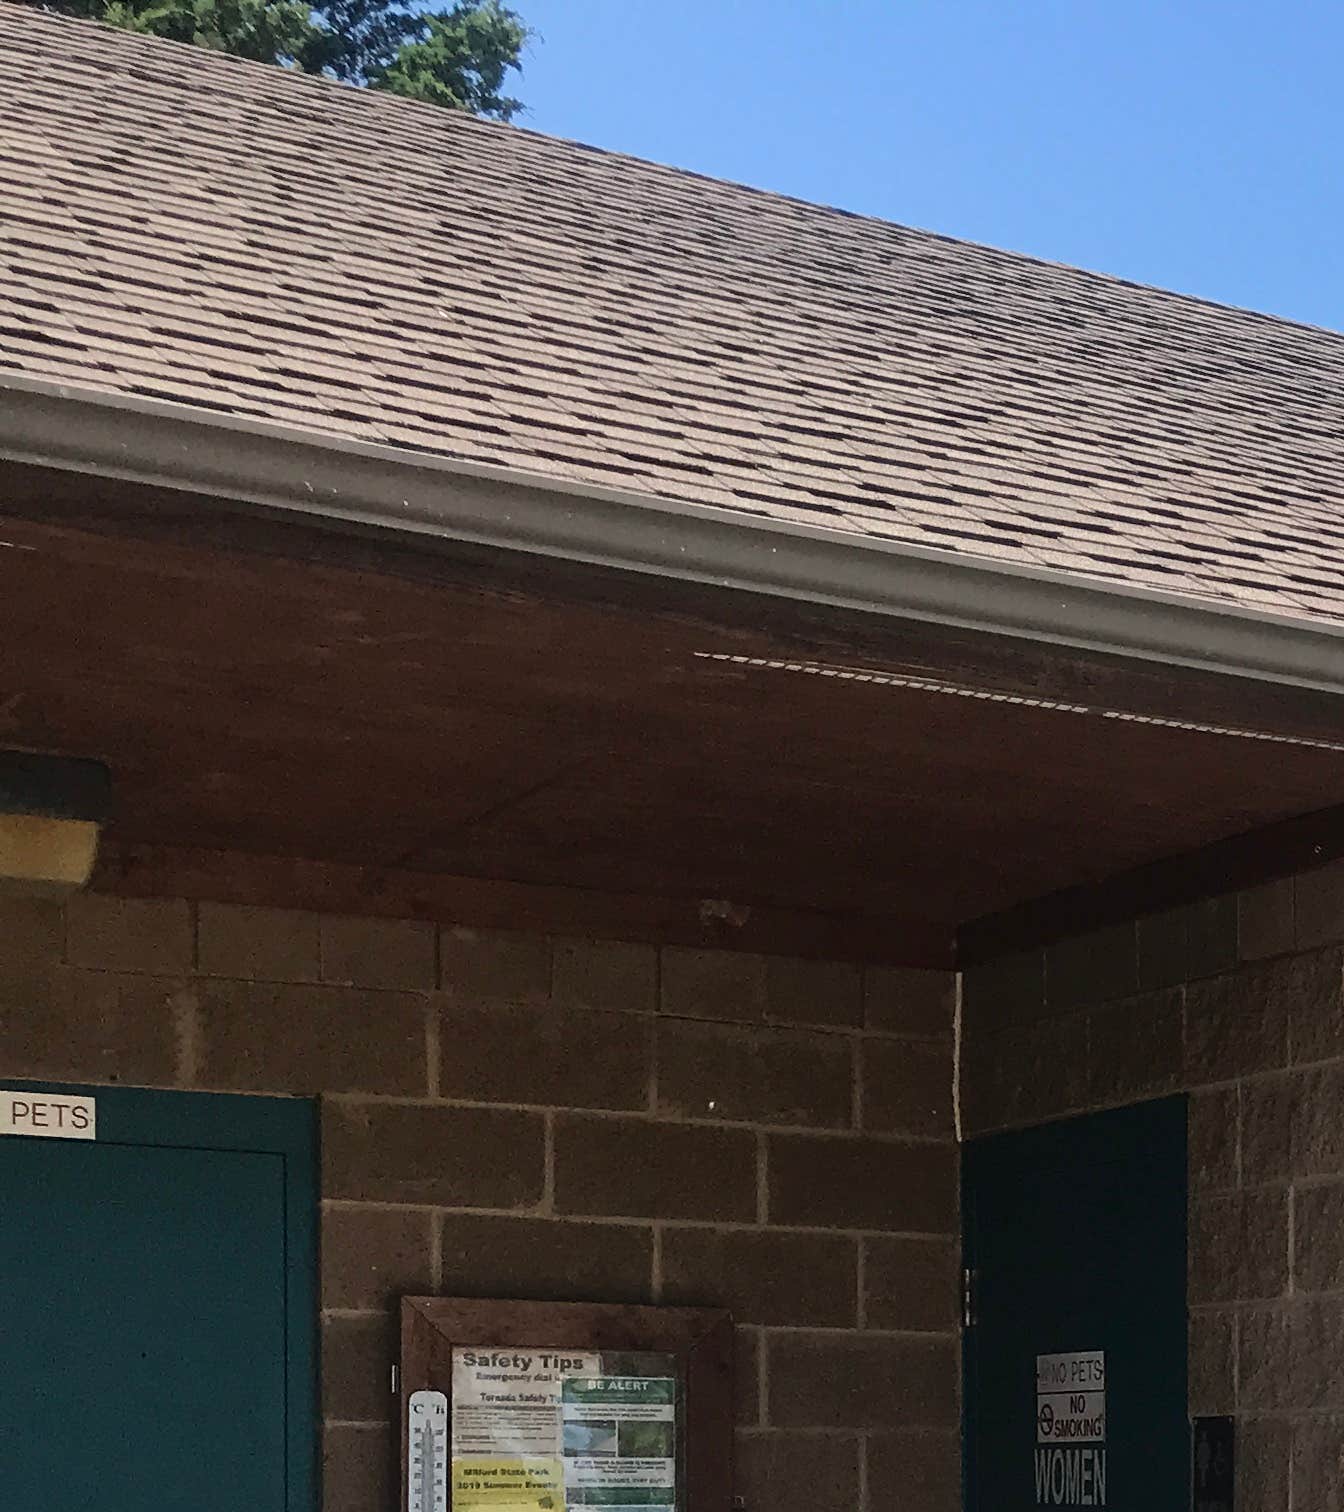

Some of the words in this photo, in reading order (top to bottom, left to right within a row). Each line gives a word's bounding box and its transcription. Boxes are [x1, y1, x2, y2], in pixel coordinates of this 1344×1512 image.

[12, 1101, 89, 1129] PETS
[463, 1353, 532, 1371] Safety
[540, 1355, 584, 1372] Tips
[1051, 1363, 1067, 1384] NO
[1071, 1359, 1103, 1383] PETS
[476, 1373, 530, 1382] Emergency
[587, 1380, 605, 1390] BE
[608, 1380, 649, 1391] ALERT
[1070, 1395, 1085, 1413] NO
[1054, 1417, 1102, 1437] SMOKING
[1034, 1448, 1107, 1505] WOMEN
